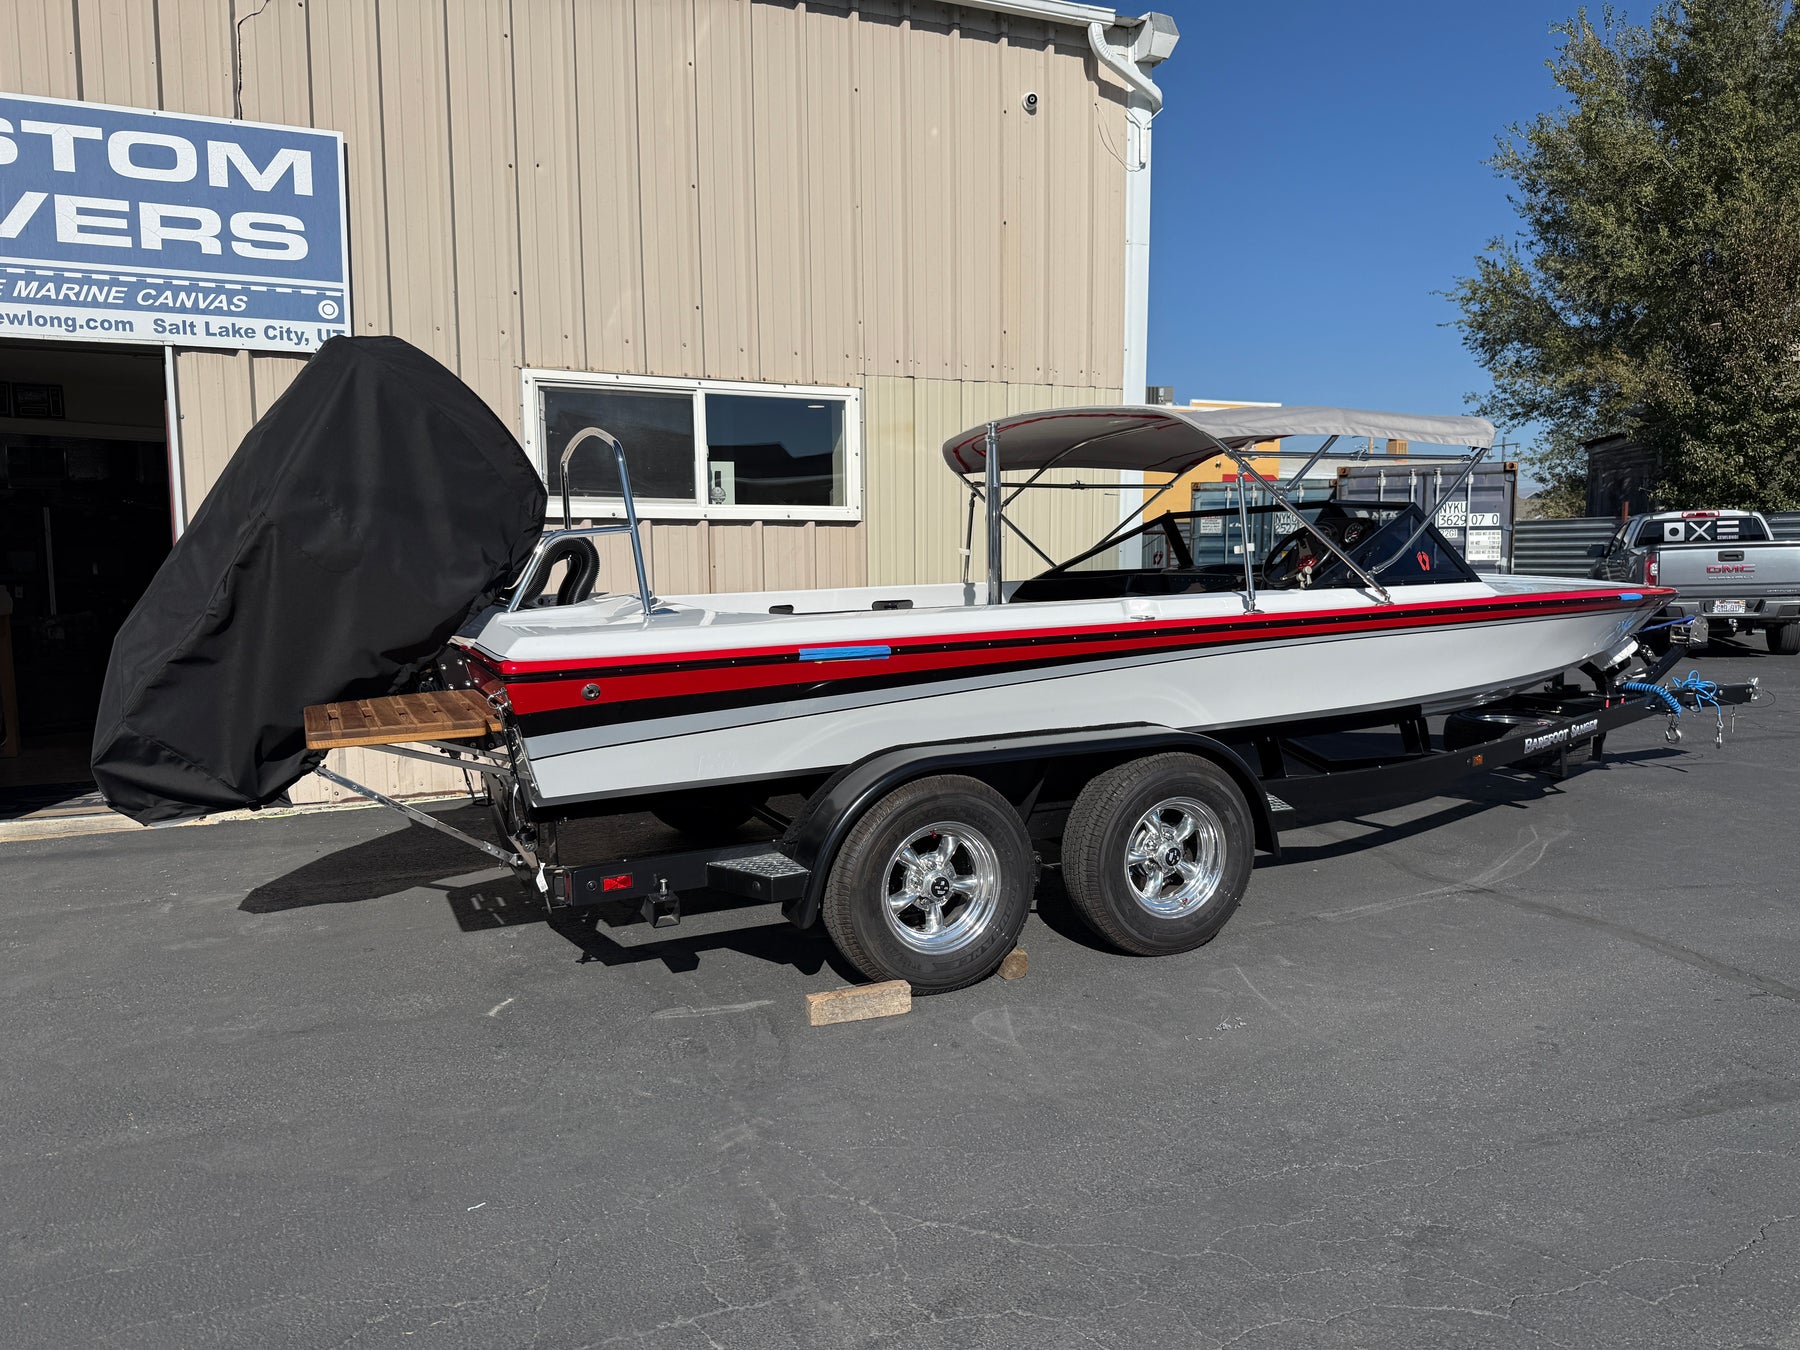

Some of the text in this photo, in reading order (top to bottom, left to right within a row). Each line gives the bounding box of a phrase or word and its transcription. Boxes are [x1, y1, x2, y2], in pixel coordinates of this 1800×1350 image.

[0, 117, 313, 196] TOM
[13, 280, 129, 304] MARINE
[137, 289, 248, 312] CANVAS
[0, 311, 134, 333] wlong.com
[153, 318, 197, 337] Salt
[205, 321, 256, 339] Lake
[264, 325, 310, 346] City,
[1707, 564, 1756, 574] GMC
[1524, 729, 1569, 754] BAREFOOT
